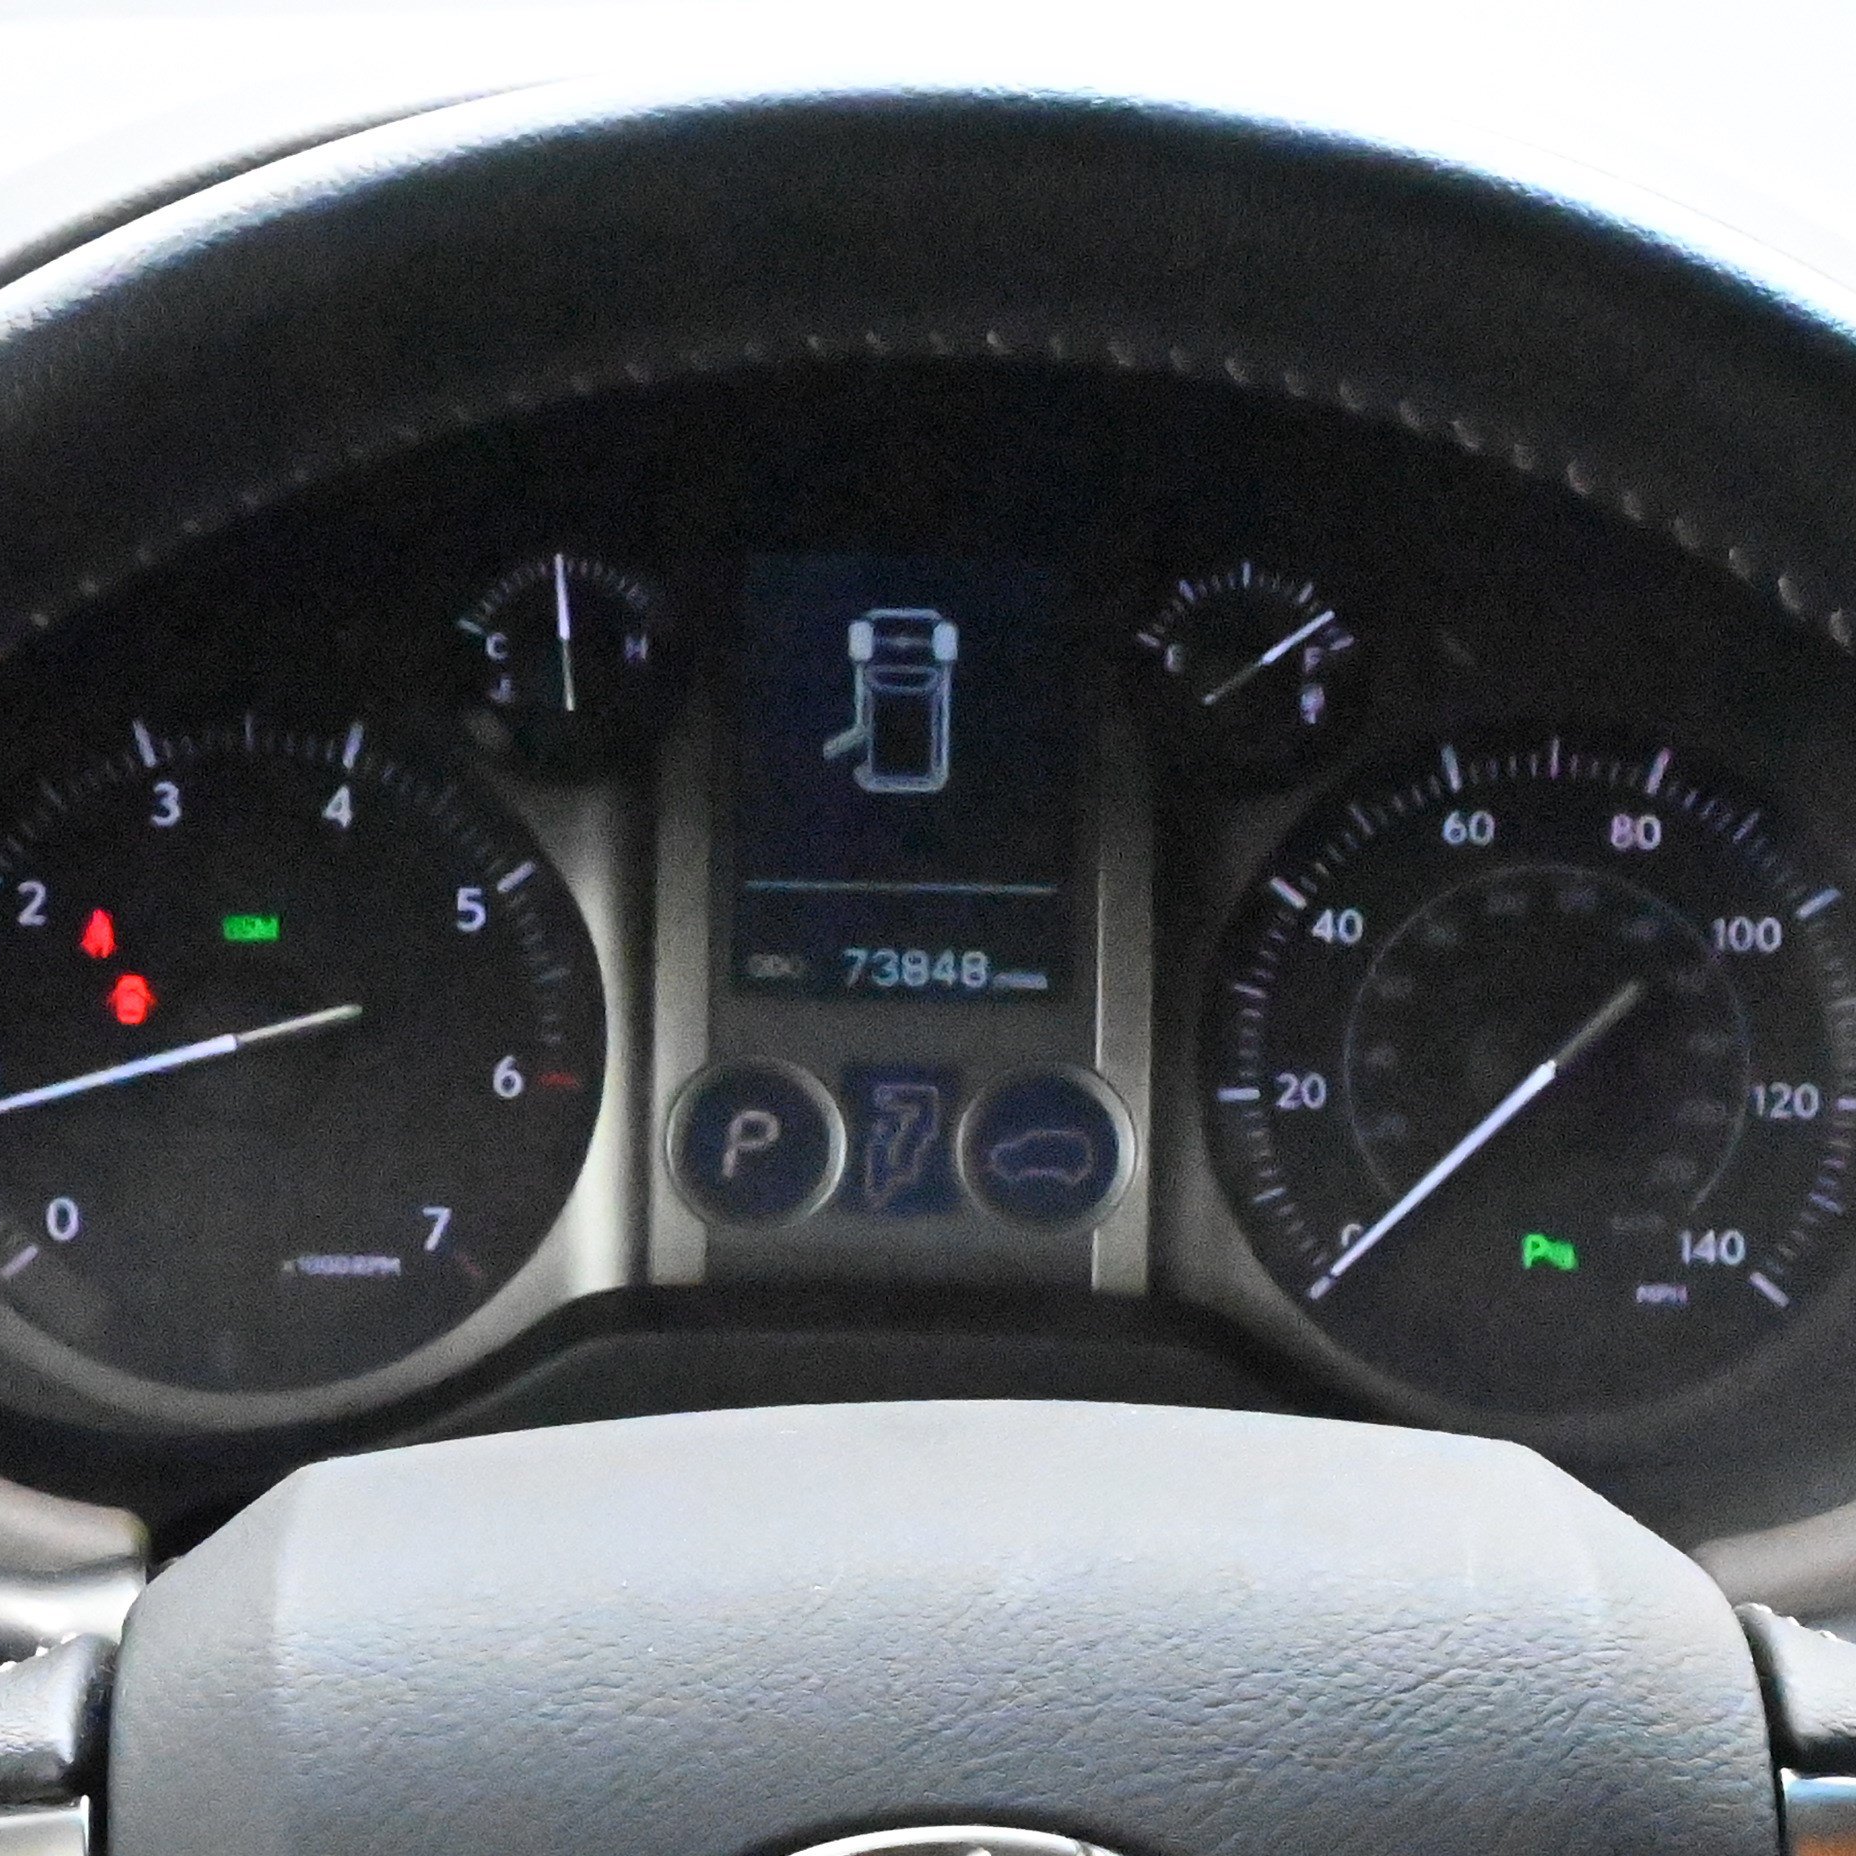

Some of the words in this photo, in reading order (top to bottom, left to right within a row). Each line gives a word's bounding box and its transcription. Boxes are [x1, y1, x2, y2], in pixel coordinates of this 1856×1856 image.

[152, 784, 181, 827] 3
[322, 787, 353, 827] 4
[1444, 812, 1495, 847] 60
[1611, 814, 1661, 851] 80
[18, 882, 48, 926] 2
[457, 887, 486, 932] 5
[1312, 909, 1363, 946] 40
[1712, 916, 1783, 952] 100
[844, 948, 987, 988] 73848
[494, 1057, 523, 1098] 6
[1277, 1073, 1327, 1110] 20
[1753, 1083, 1820, 1119] 120
[48, 1199, 80, 1241] 0
[423, 1207, 452, 1251] 7
[1682, 1229, 1745, 1266] 140
